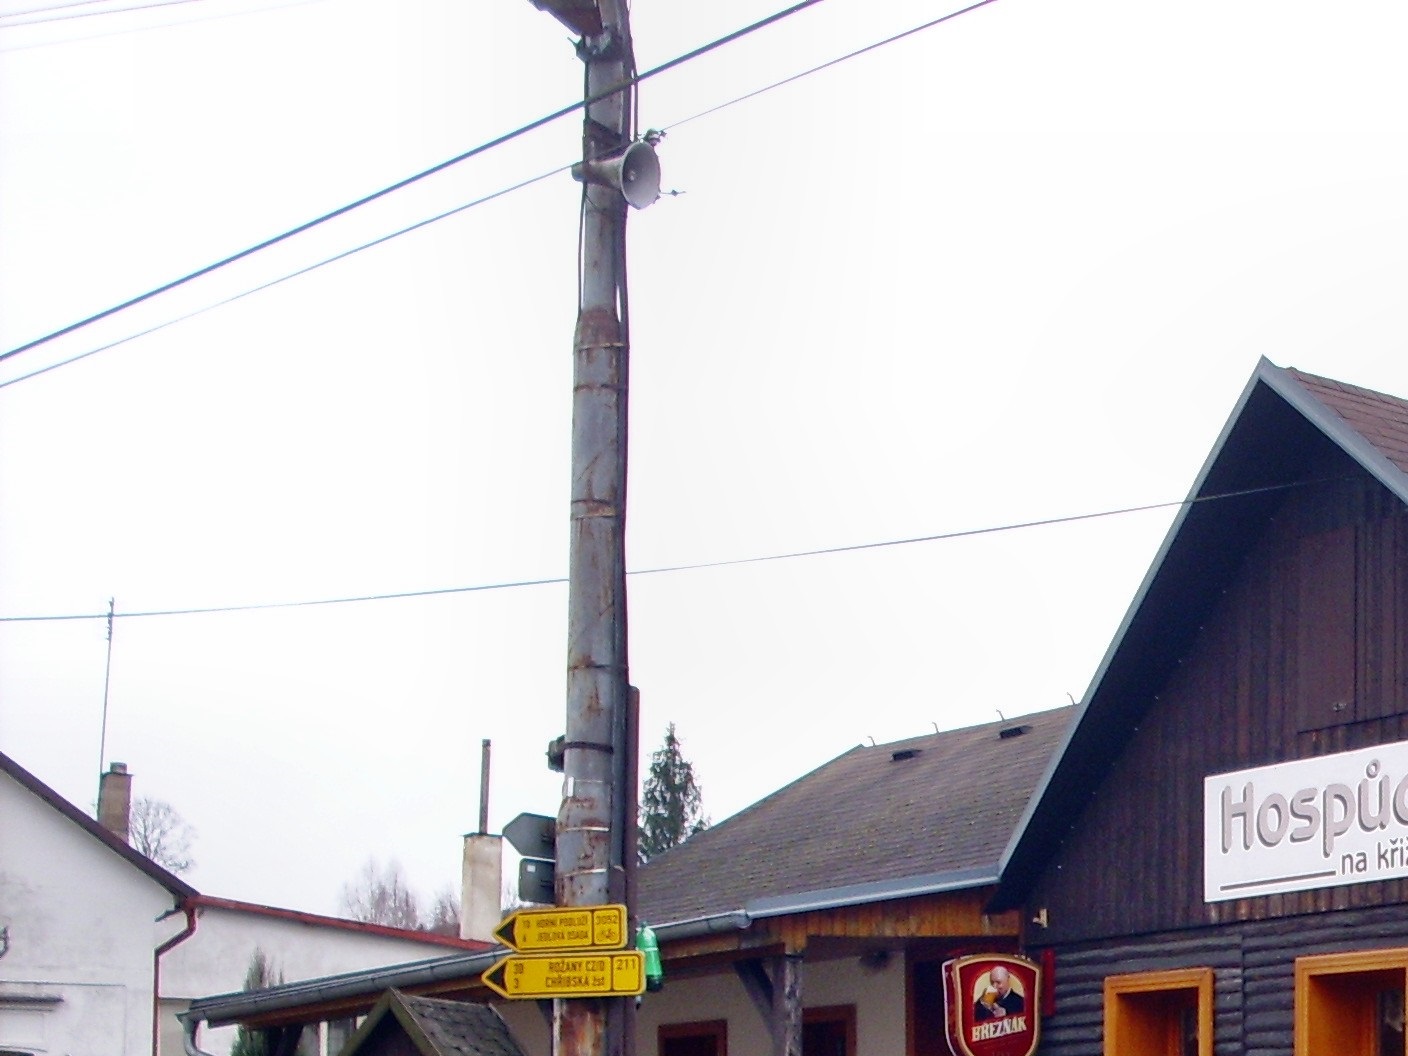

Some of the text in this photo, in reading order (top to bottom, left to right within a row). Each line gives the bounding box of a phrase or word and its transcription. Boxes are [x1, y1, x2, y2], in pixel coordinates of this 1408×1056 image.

[1341, 850, 1368, 876] na
[616, 958, 636, 970] 211
[513, 977, 519, 989] 3
